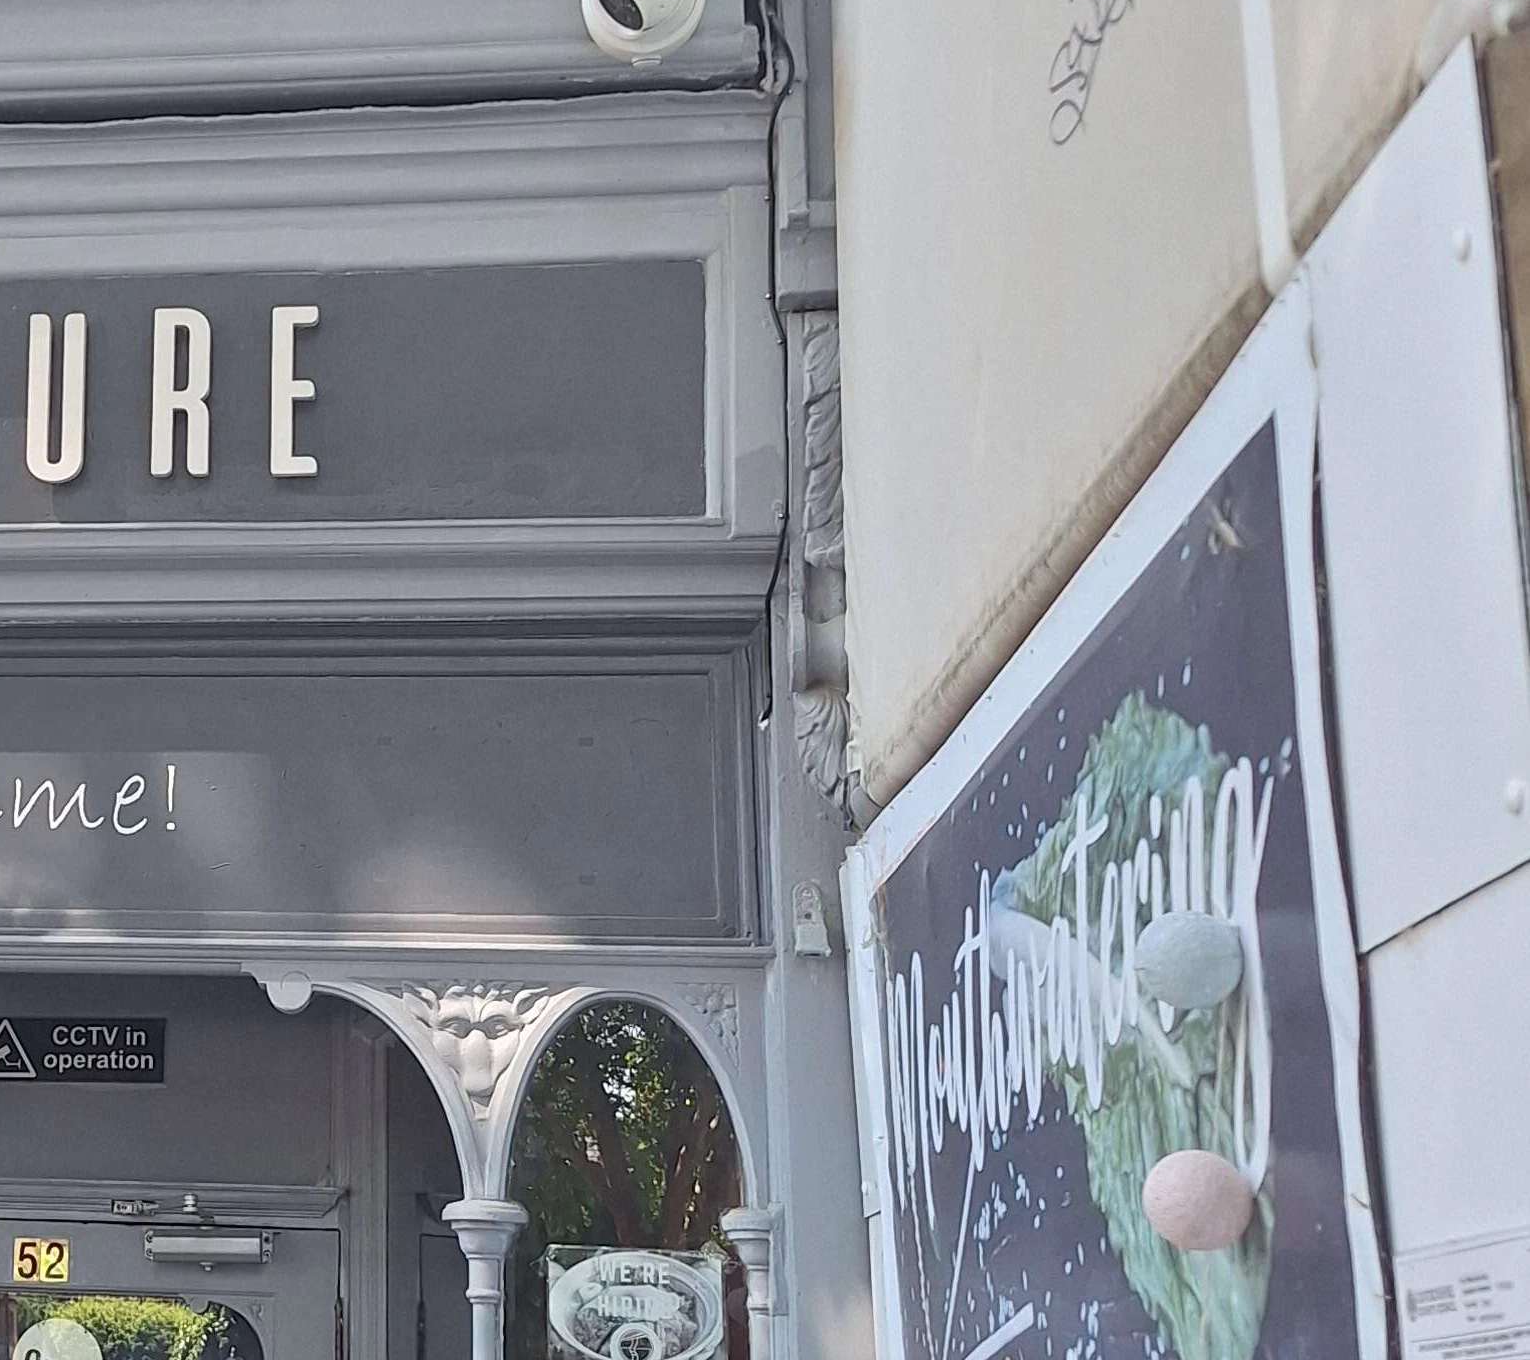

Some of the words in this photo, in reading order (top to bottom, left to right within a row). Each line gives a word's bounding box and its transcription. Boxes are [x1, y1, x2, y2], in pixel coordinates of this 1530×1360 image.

[52, 1025, 118, 1047] CCTV
[125, 1025, 146, 1046] in
[43, 1051, 154, 1074] operation
[17, 1241, 66, 1280] 52
